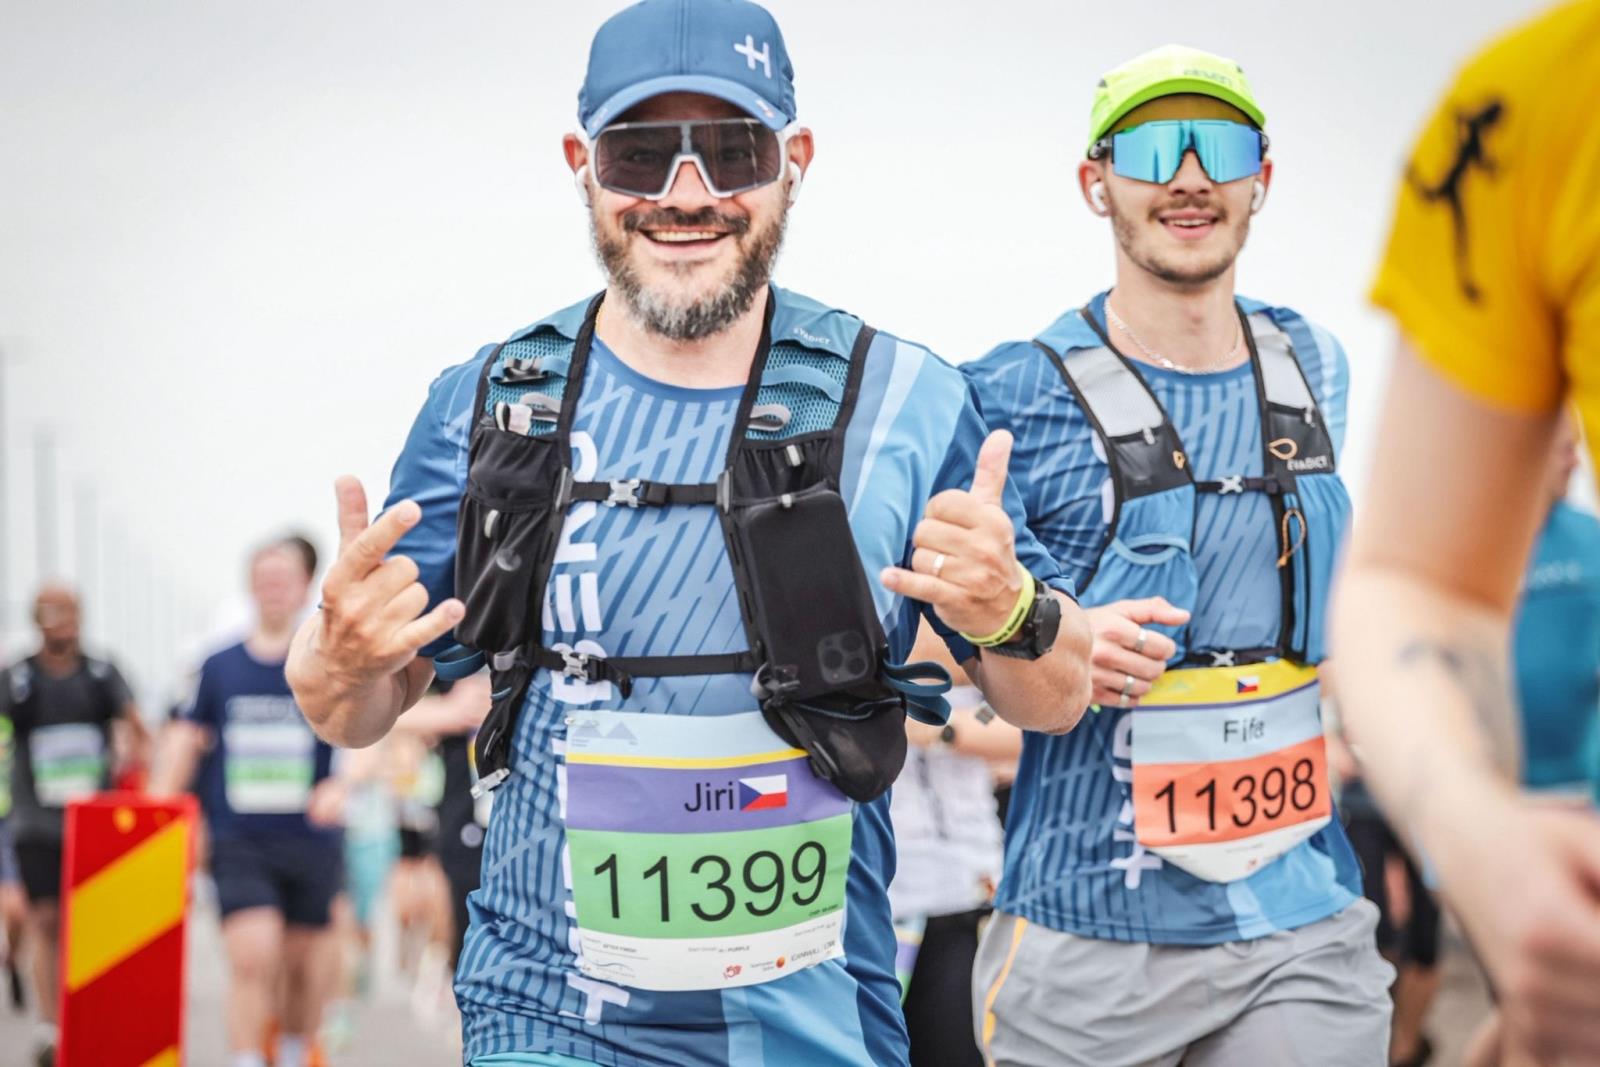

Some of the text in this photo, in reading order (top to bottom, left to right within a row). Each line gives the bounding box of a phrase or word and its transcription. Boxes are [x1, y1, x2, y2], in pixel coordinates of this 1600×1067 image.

[684, 781, 735, 813] Jiri
[1154, 758, 1316, 834] 11398
[594, 840, 828, 923] 11399
